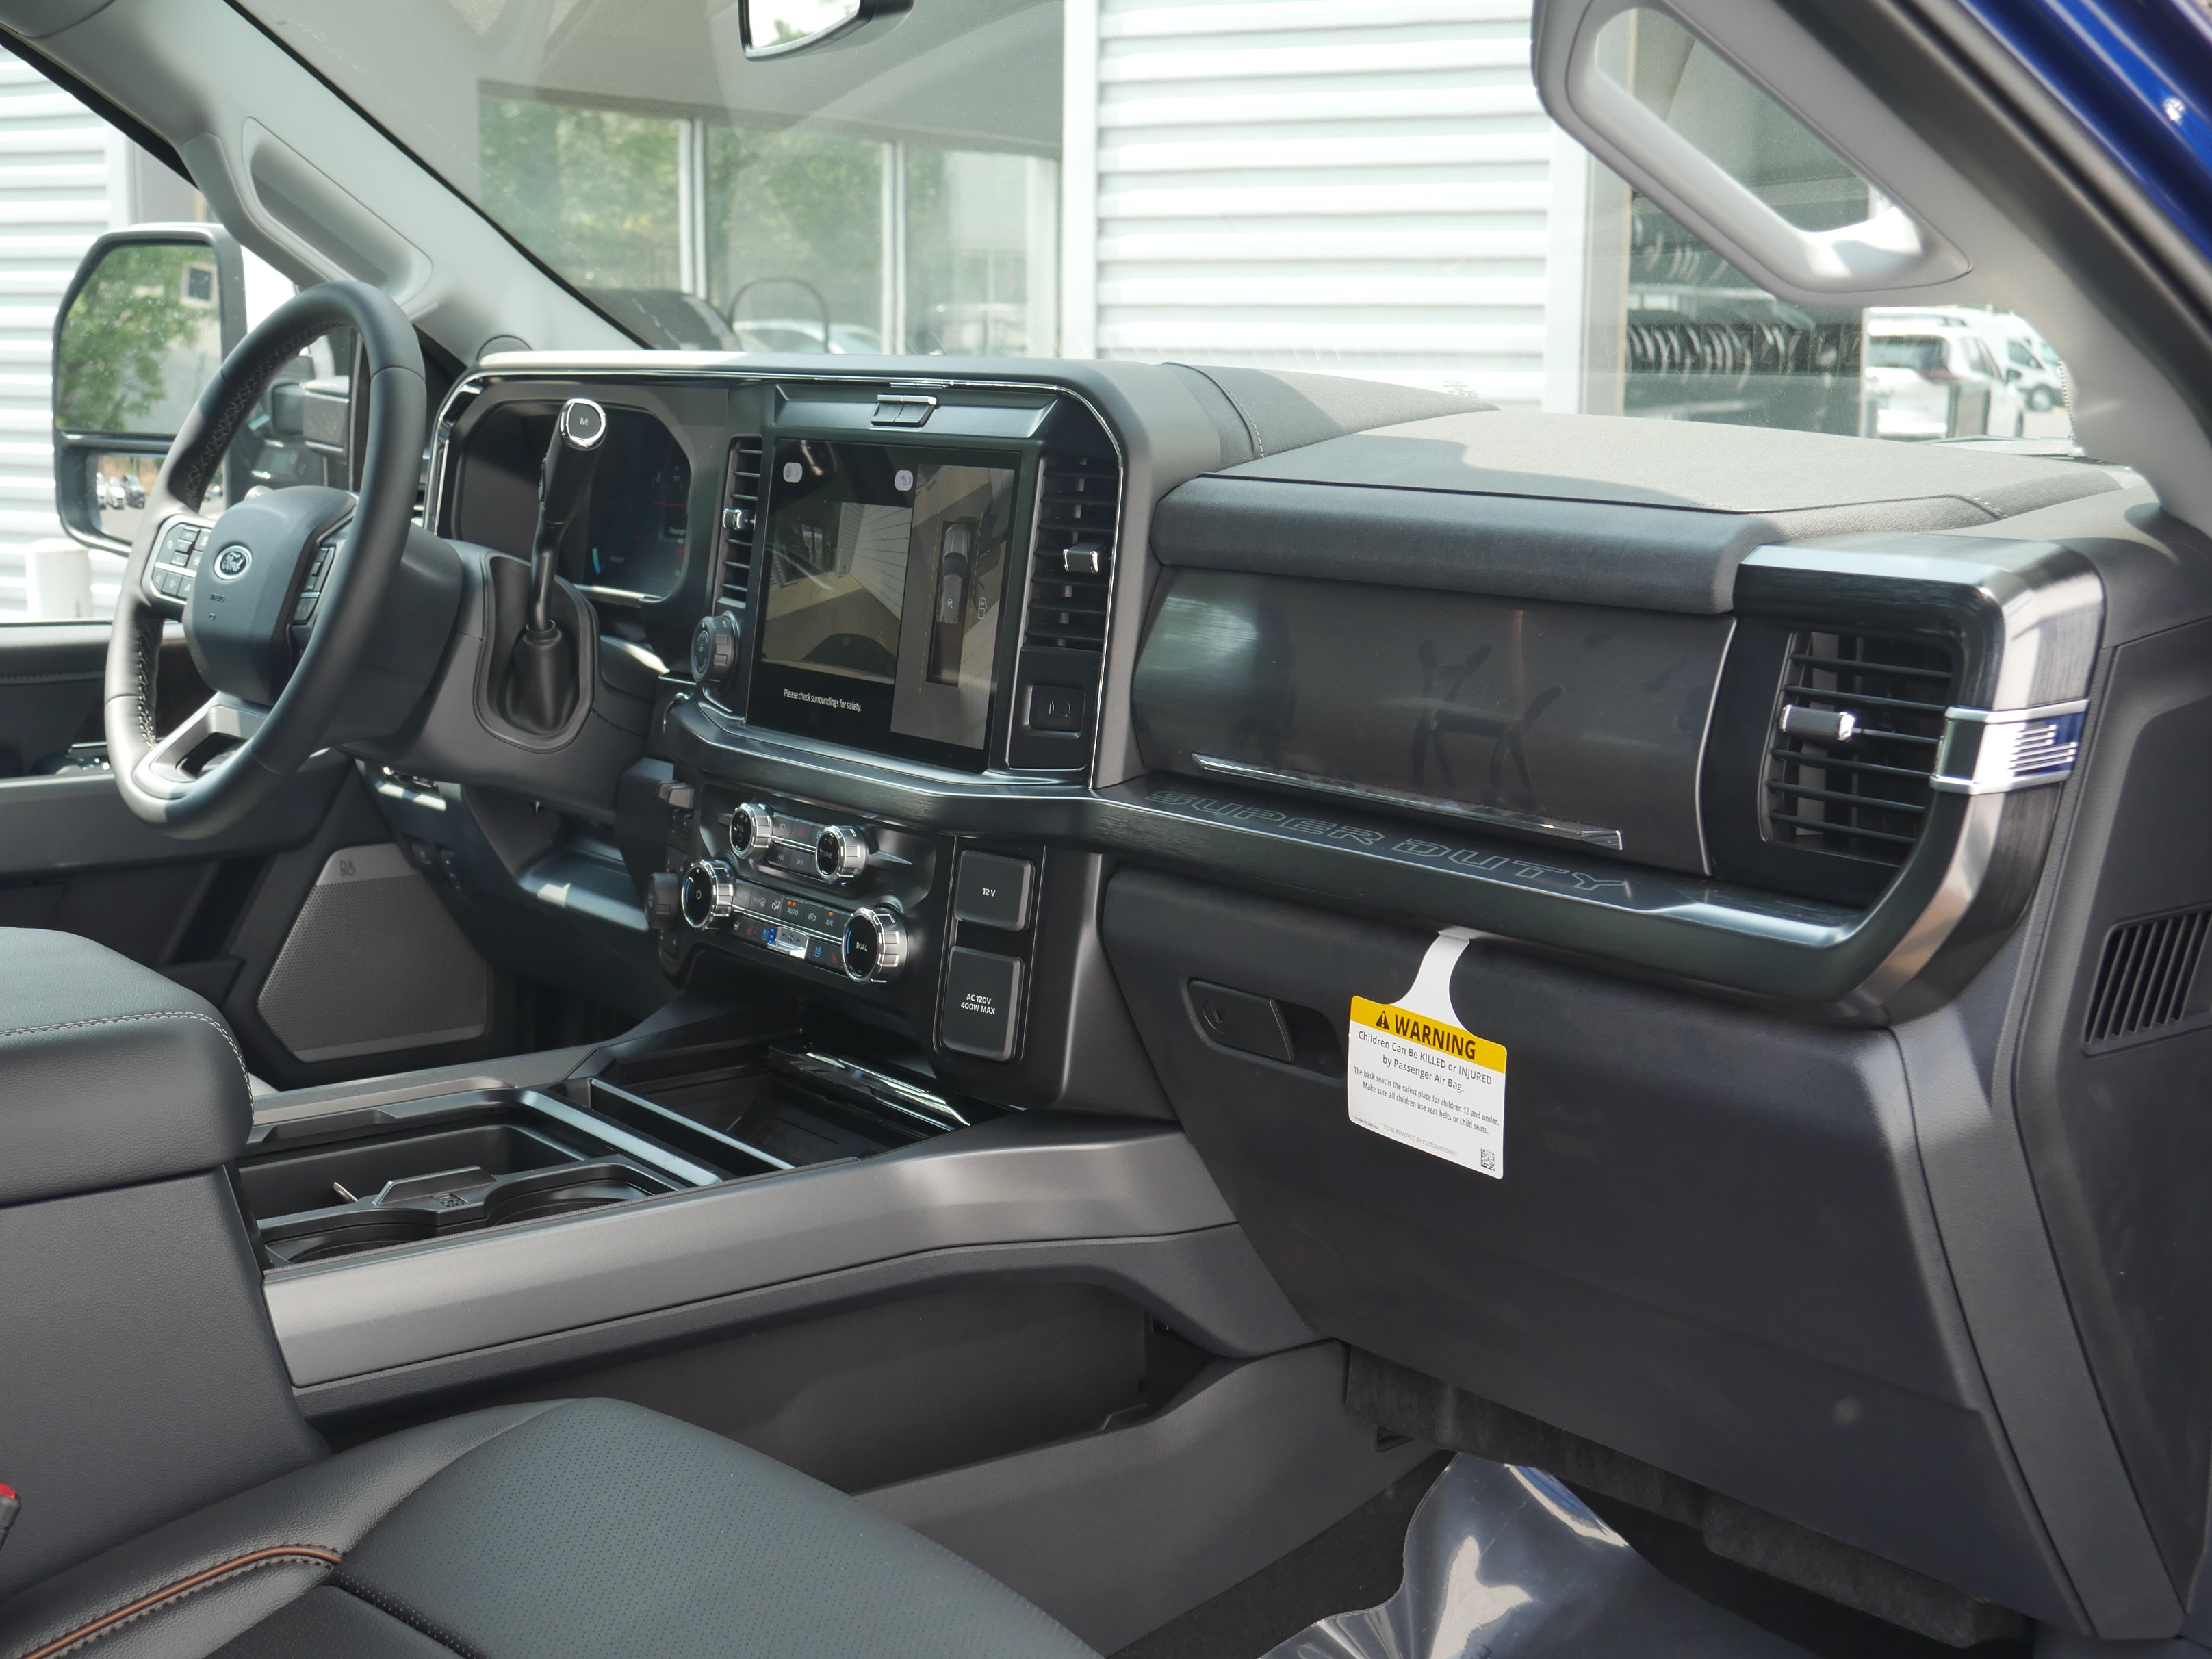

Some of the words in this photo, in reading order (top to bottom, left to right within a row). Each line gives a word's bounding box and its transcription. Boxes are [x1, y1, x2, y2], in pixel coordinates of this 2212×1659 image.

[580, 417, 589, 426] M
[783, 688, 798, 699] Please
[798, 691, 811, 702] check
[811, 695, 839, 708] surroundings
[846, 701, 862, 713] safety.
[1144, 790, 1385, 847] SUPER
[1391, 837, 1628, 891] DUTY
[787, 907, 799, 916] AUTO
[825, 919, 834, 927] A/C
[856, 942, 869, 952] DUAL
[960, 1002, 981, 1012] 400W
[981, 1005, 996, 1015] MAX
[966, 994, 975, 1003] AC
[976, 995, 992, 1005] 120V
[1395, 1014, 1476, 1060] WARNING
[1359, 1031, 1390, 1049] Children
[1392, 1042, 1406, 1055] Can
[1409, 1048, 1418, 1059] Be
[1420, 1052, 1446, 1068] KILLED
[1448, 1064, 1457, 1072] or
[1459, 1066, 1492, 1085] INJURED
[1382, 1055, 1392, 1067] by
[1394, 1059, 1432, 1080] Passenger
[1435, 1074, 1445, 1085] Air
[1448, 1079, 1464, 1094] Bag.
[1354, 1066, 1363, 1076] The
[1364, 1070, 1375, 1081] back
[1376, 1076, 1387, 1085] seat
[1387, 1078, 1391, 1087] is
[1393, 1081, 1401, 1090] the
[1402, 1085, 1417, 1096] safest
[1418, 1090, 1431, 1101] place
[1441, 1098, 1462, 1112] children
[1463, 1106, 1469, 1115] 12
[1471, 1110, 1481, 1119] and
[1482, 1114, 1500, 1126] under.
[1363, 1081, 1376, 1093] Make
[1377, 1088, 1388, 1097] sure
[1396, 1094, 1416, 1108] children
[1417, 1103, 1426, 1111] use
[1427, 1106, 1438, 1116] seat
[1439, 1109, 1452, 1121] belts
[1460, 1118, 1472, 1128] child
[1474, 1123, 1489, 1135] seats.
[1396, 1129, 1416, 1141] REMOVED
[1416, 1135, 1422, 1143] BY
[1422, 1139, 1445, 1152] CUSTOMER
[1445, 1147, 1458, 1157] ONLY
